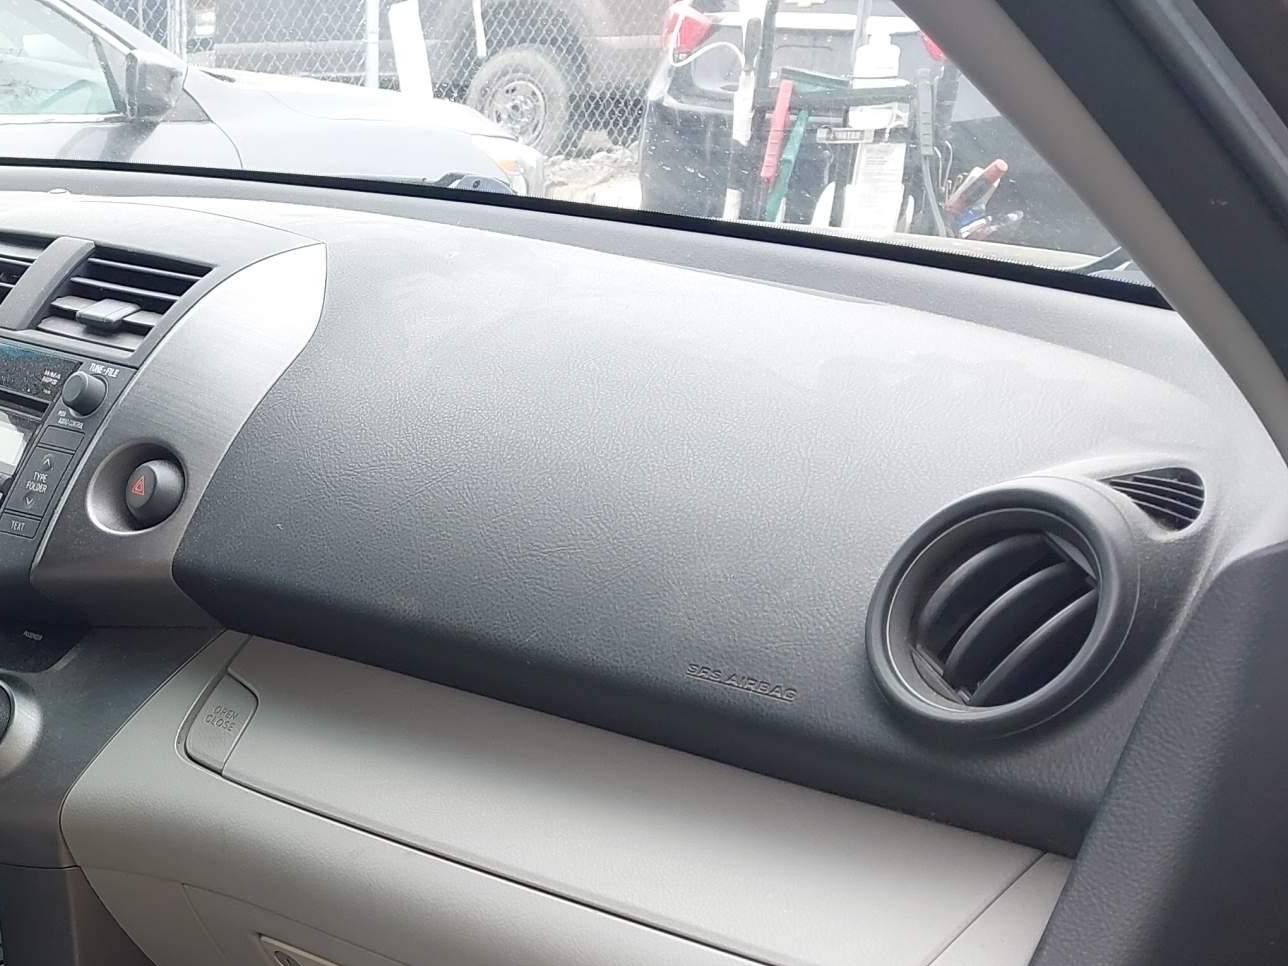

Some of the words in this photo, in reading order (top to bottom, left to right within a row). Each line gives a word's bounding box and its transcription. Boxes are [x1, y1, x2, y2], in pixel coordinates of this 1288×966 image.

[33, 471, 48, 483] TYPE
[26, 480, 48, 494] FOLDER
[10, 520, 26, 531] TEXT
[686, 663, 722, 680] SRS
[726, 673, 798, 700] AIRBAG
[214, 705, 239, 720] OPEN
[205, 714, 236, 731] CLOSE
